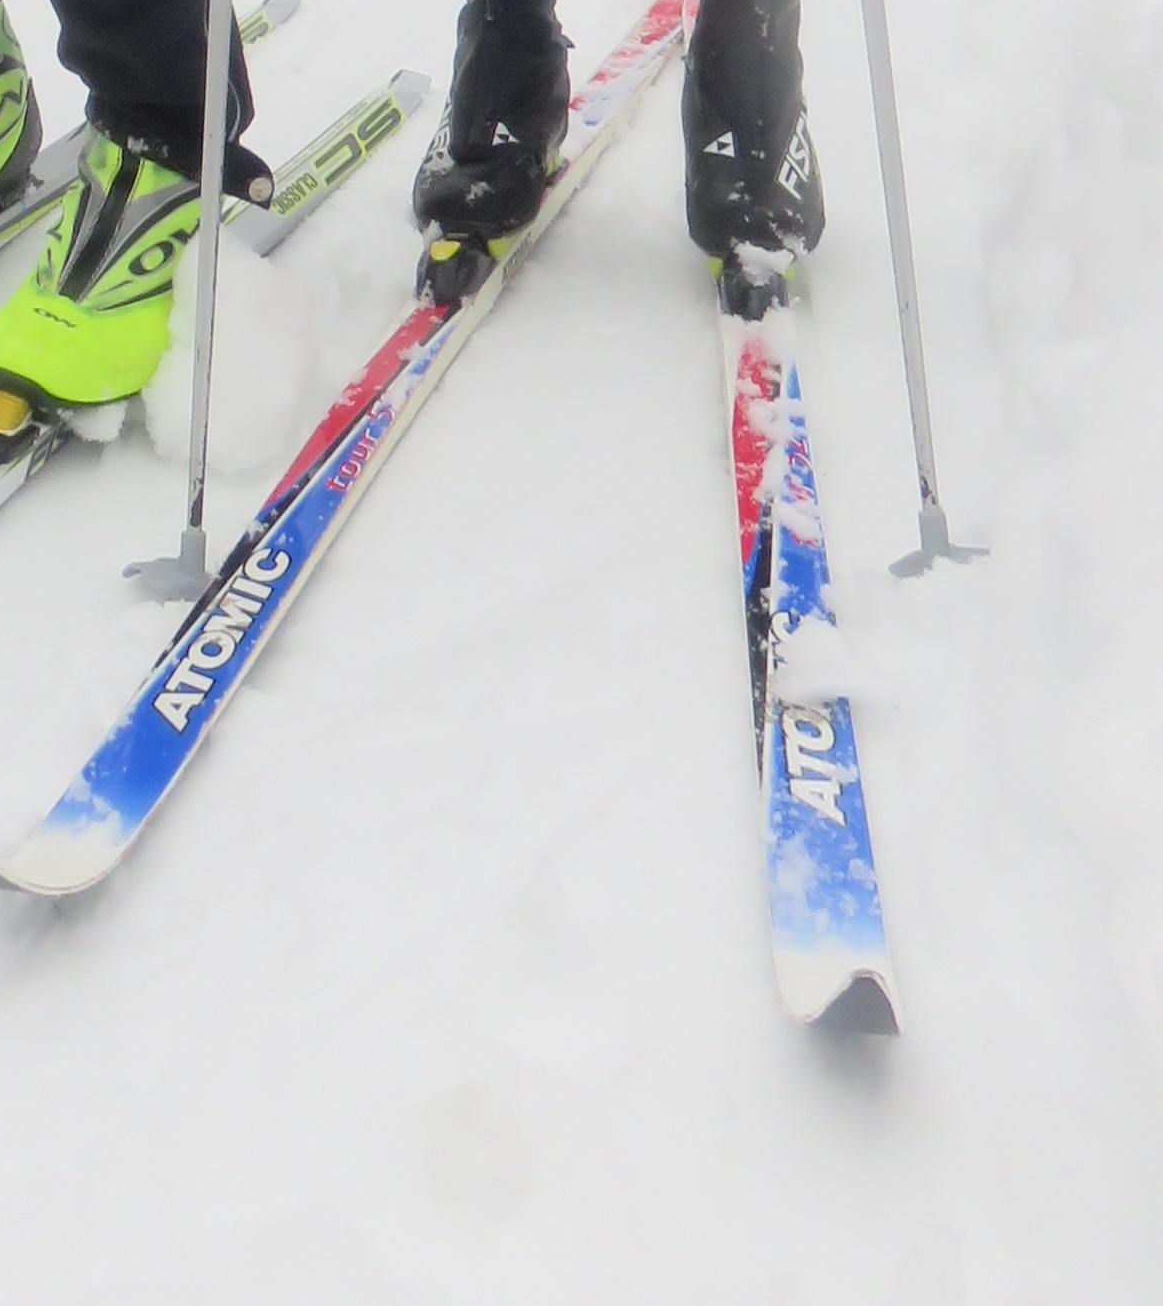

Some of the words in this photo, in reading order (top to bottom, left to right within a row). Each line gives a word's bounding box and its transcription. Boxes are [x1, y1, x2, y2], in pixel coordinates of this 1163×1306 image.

[272, 172, 319, 216] CLASSIC
[777, 103, 810, 201] FISC
[151, 546, 293, 735] ATOMIC
